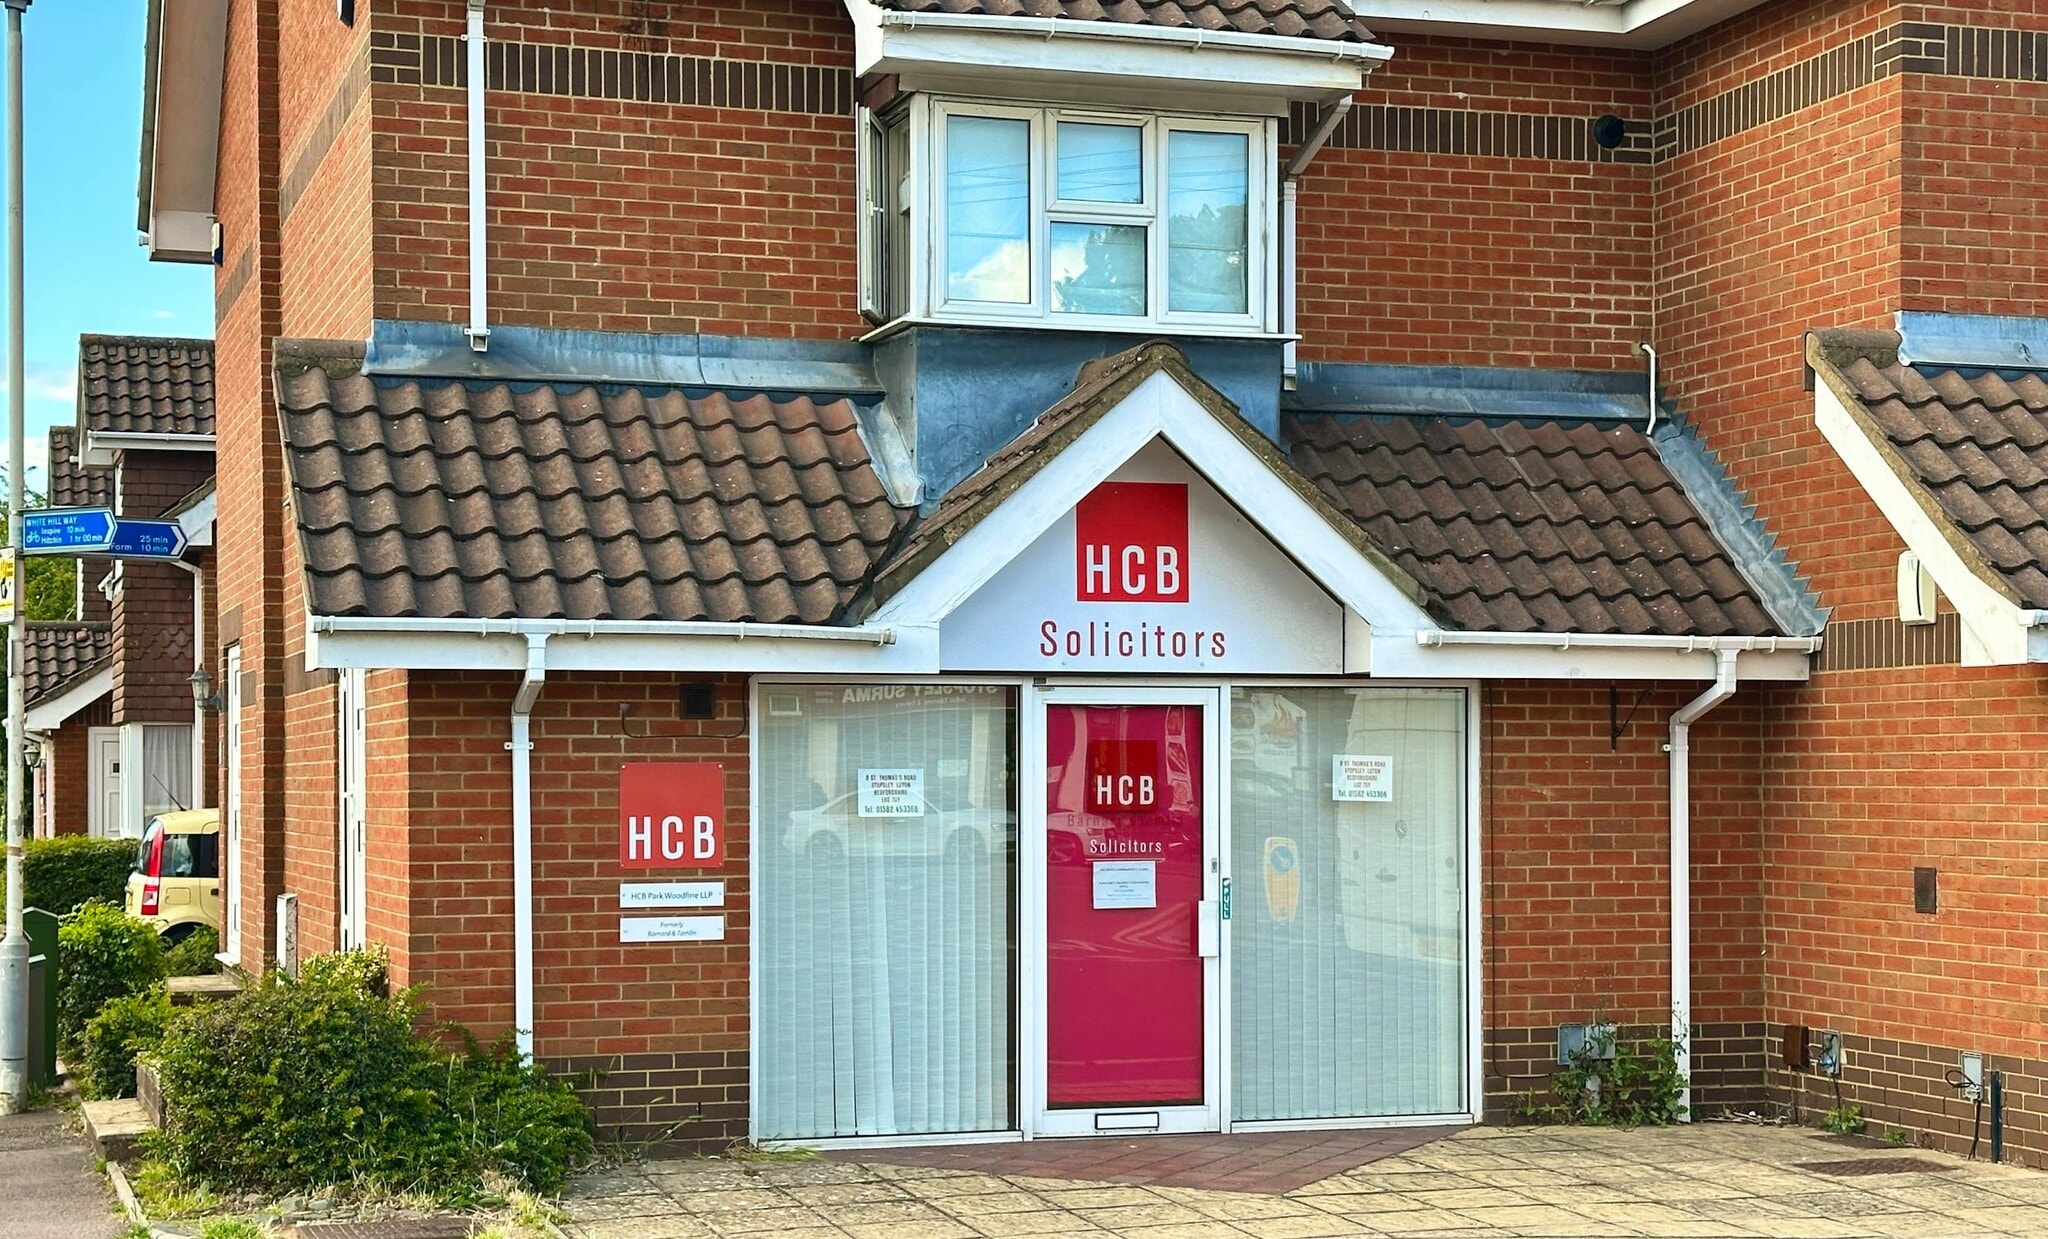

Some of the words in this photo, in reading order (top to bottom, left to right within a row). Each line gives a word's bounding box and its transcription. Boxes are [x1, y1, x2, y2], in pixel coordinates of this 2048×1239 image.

[26, 517, 46, 527] WHITE
[48, 517, 62, 526] HILL
[63, 516, 77, 525] WAY
[66, 526, 74, 534] 10
[91, 534, 103, 542] min
[140, 535, 151, 543] 25
[152, 535, 168, 544] min
[141, 544, 151, 552] 10
[152, 545, 168, 553] min
[1086, 544, 1180, 595] HCB
[1039, 619, 1226, 658] Solicitors
[1096, 775, 1154, 806] HCB
[629, 815, 716, 860] HCB
[1090, 838, 1162, 854] Solicitors
[631, 892, 647, 900] HCB
[648, 892, 663, 900] Park
[664, 891, 699, 899] Woodfine
[700, 891, 713, 899] LLP
[1222, 887, 1231, 918] PULL
[660, 921, 684, 929] Formerly
